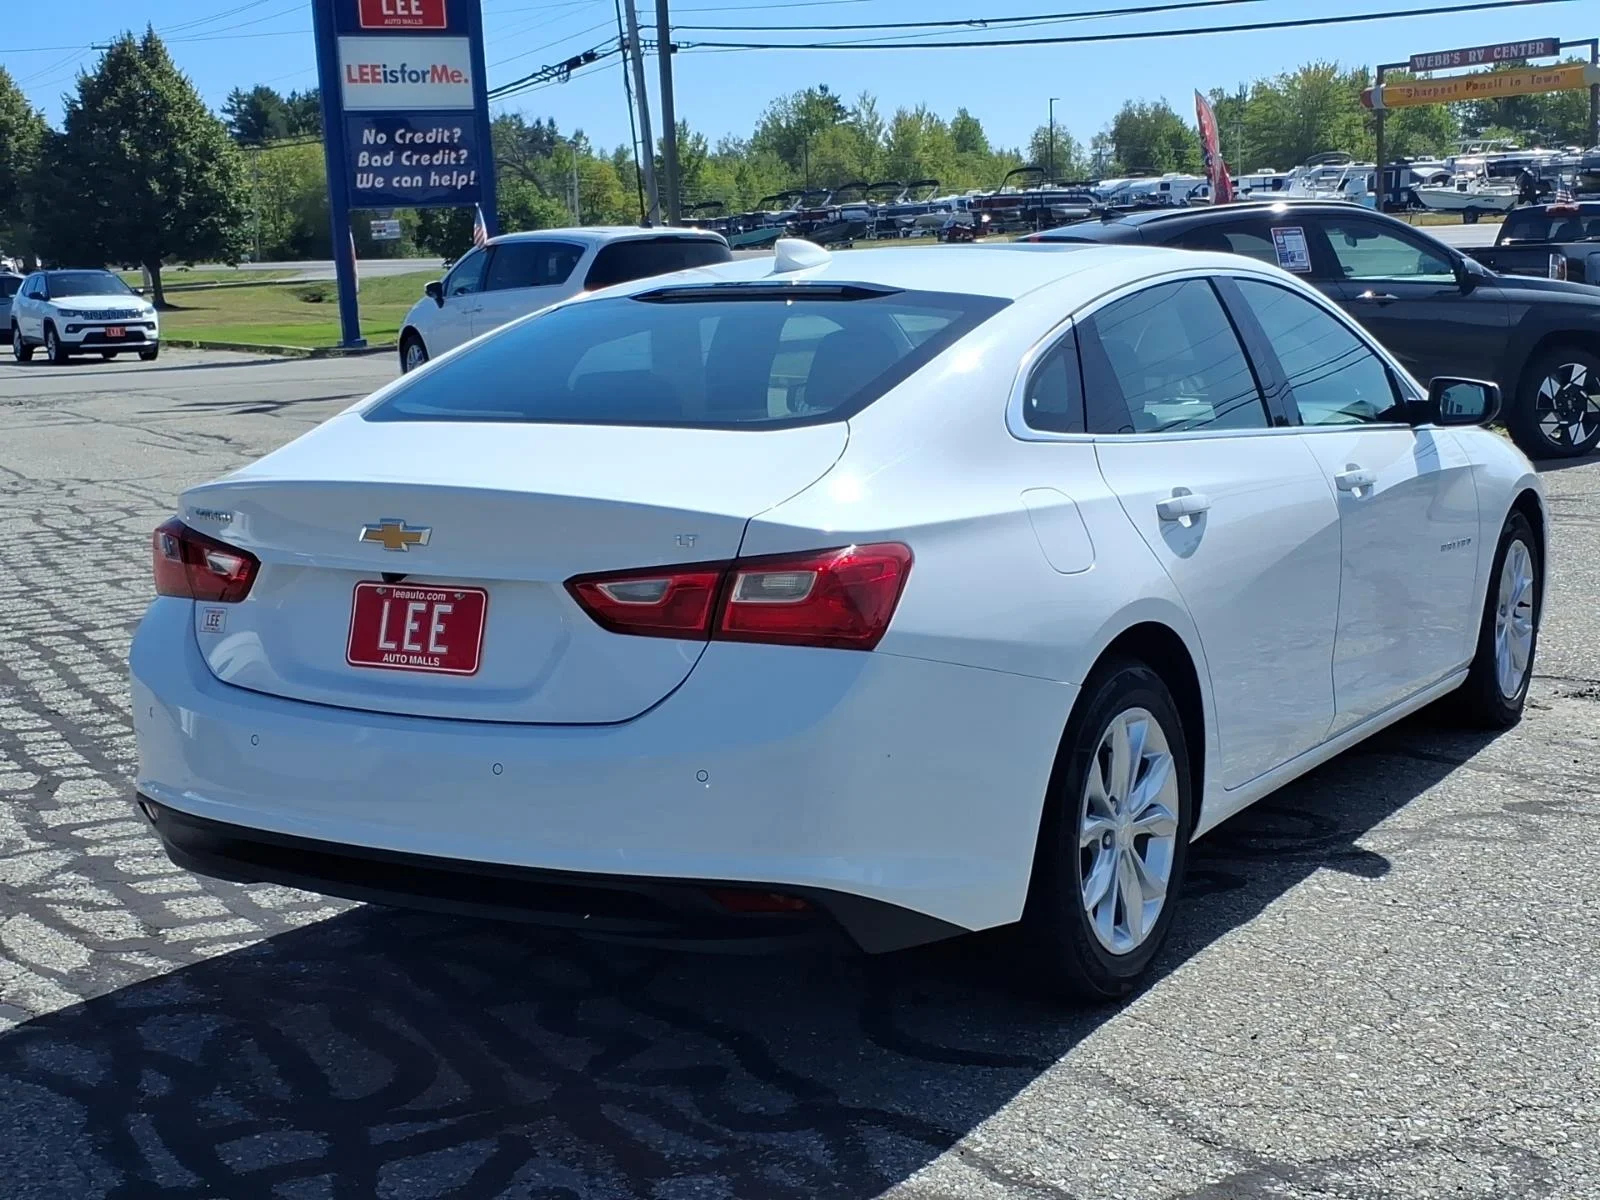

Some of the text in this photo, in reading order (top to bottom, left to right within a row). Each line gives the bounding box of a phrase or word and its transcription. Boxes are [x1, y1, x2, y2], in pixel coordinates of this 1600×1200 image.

[381, 0, 423, 15] LEE
[1415, 42, 1544, 69] WEBB'S RV CENTER
[346, 63, 469, 84] LEEisforMe.
[362, 128, 462, 145] No Credit?
[358, 150, 468, 167] Bad Credit?
[356, 171, 475, 190] We can help!
[674, 534, 698, 548] LT
[392, 588, 446, 601] leeauto.com
[206, 614, 220, 627] LEE
[378, 601, 452, 652] LEE
[383, 653, 440, 667] AUTO MALLS
